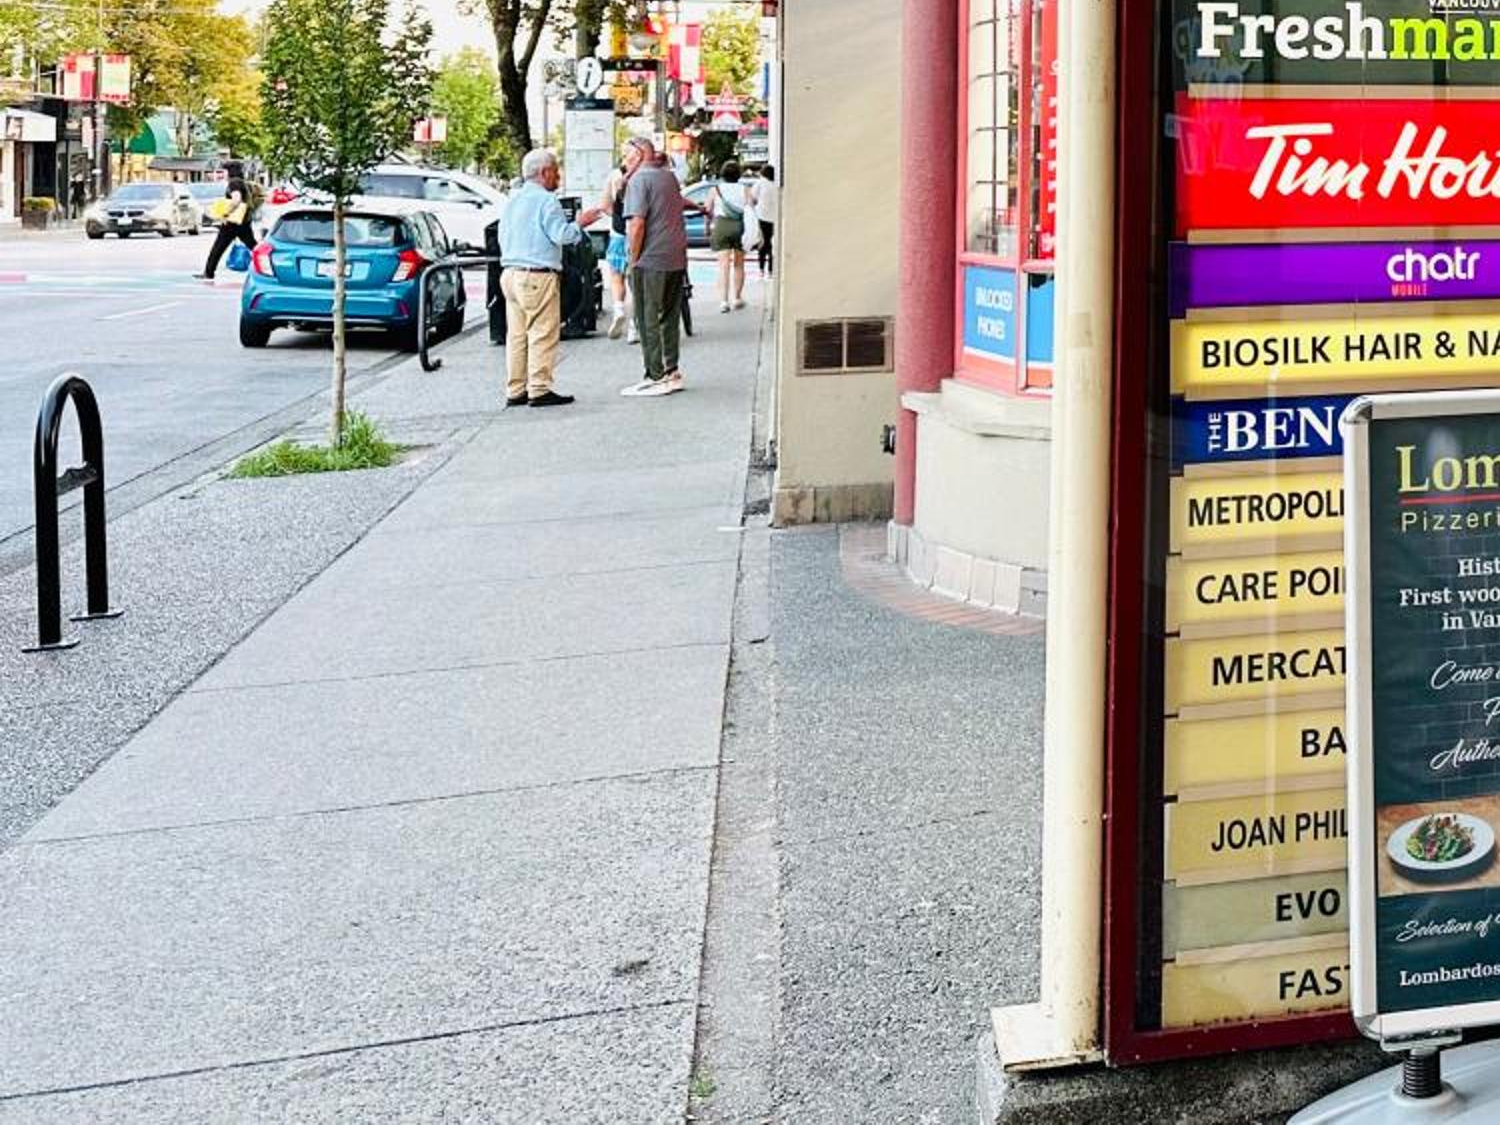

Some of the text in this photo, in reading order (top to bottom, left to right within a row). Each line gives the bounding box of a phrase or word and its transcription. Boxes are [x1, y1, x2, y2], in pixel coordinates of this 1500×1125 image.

[1246, 122, 1370, 200] Tim
[1386, 246, 1480, 281] chatr
[1202, 335, 1331, 368] BIOSILK
[1344, 331, 1423, 362] HAIR
[1434, 331, 1456, 358] &
[1223, 407, 1345, 452] BEN
[1196, 567, 1346, 604] CARE POI
[1400, 588, 1452, 607] First
[1442, 612, 1464, 631] in
[1430, 661, 1493, 690] Come
[1211, 815, 1285, 852] JOAN
[1275, 888, 1340, 922] EVO
[1395, 919, 1473, 943] Selection
[1474, 913, 1493, 937] of
